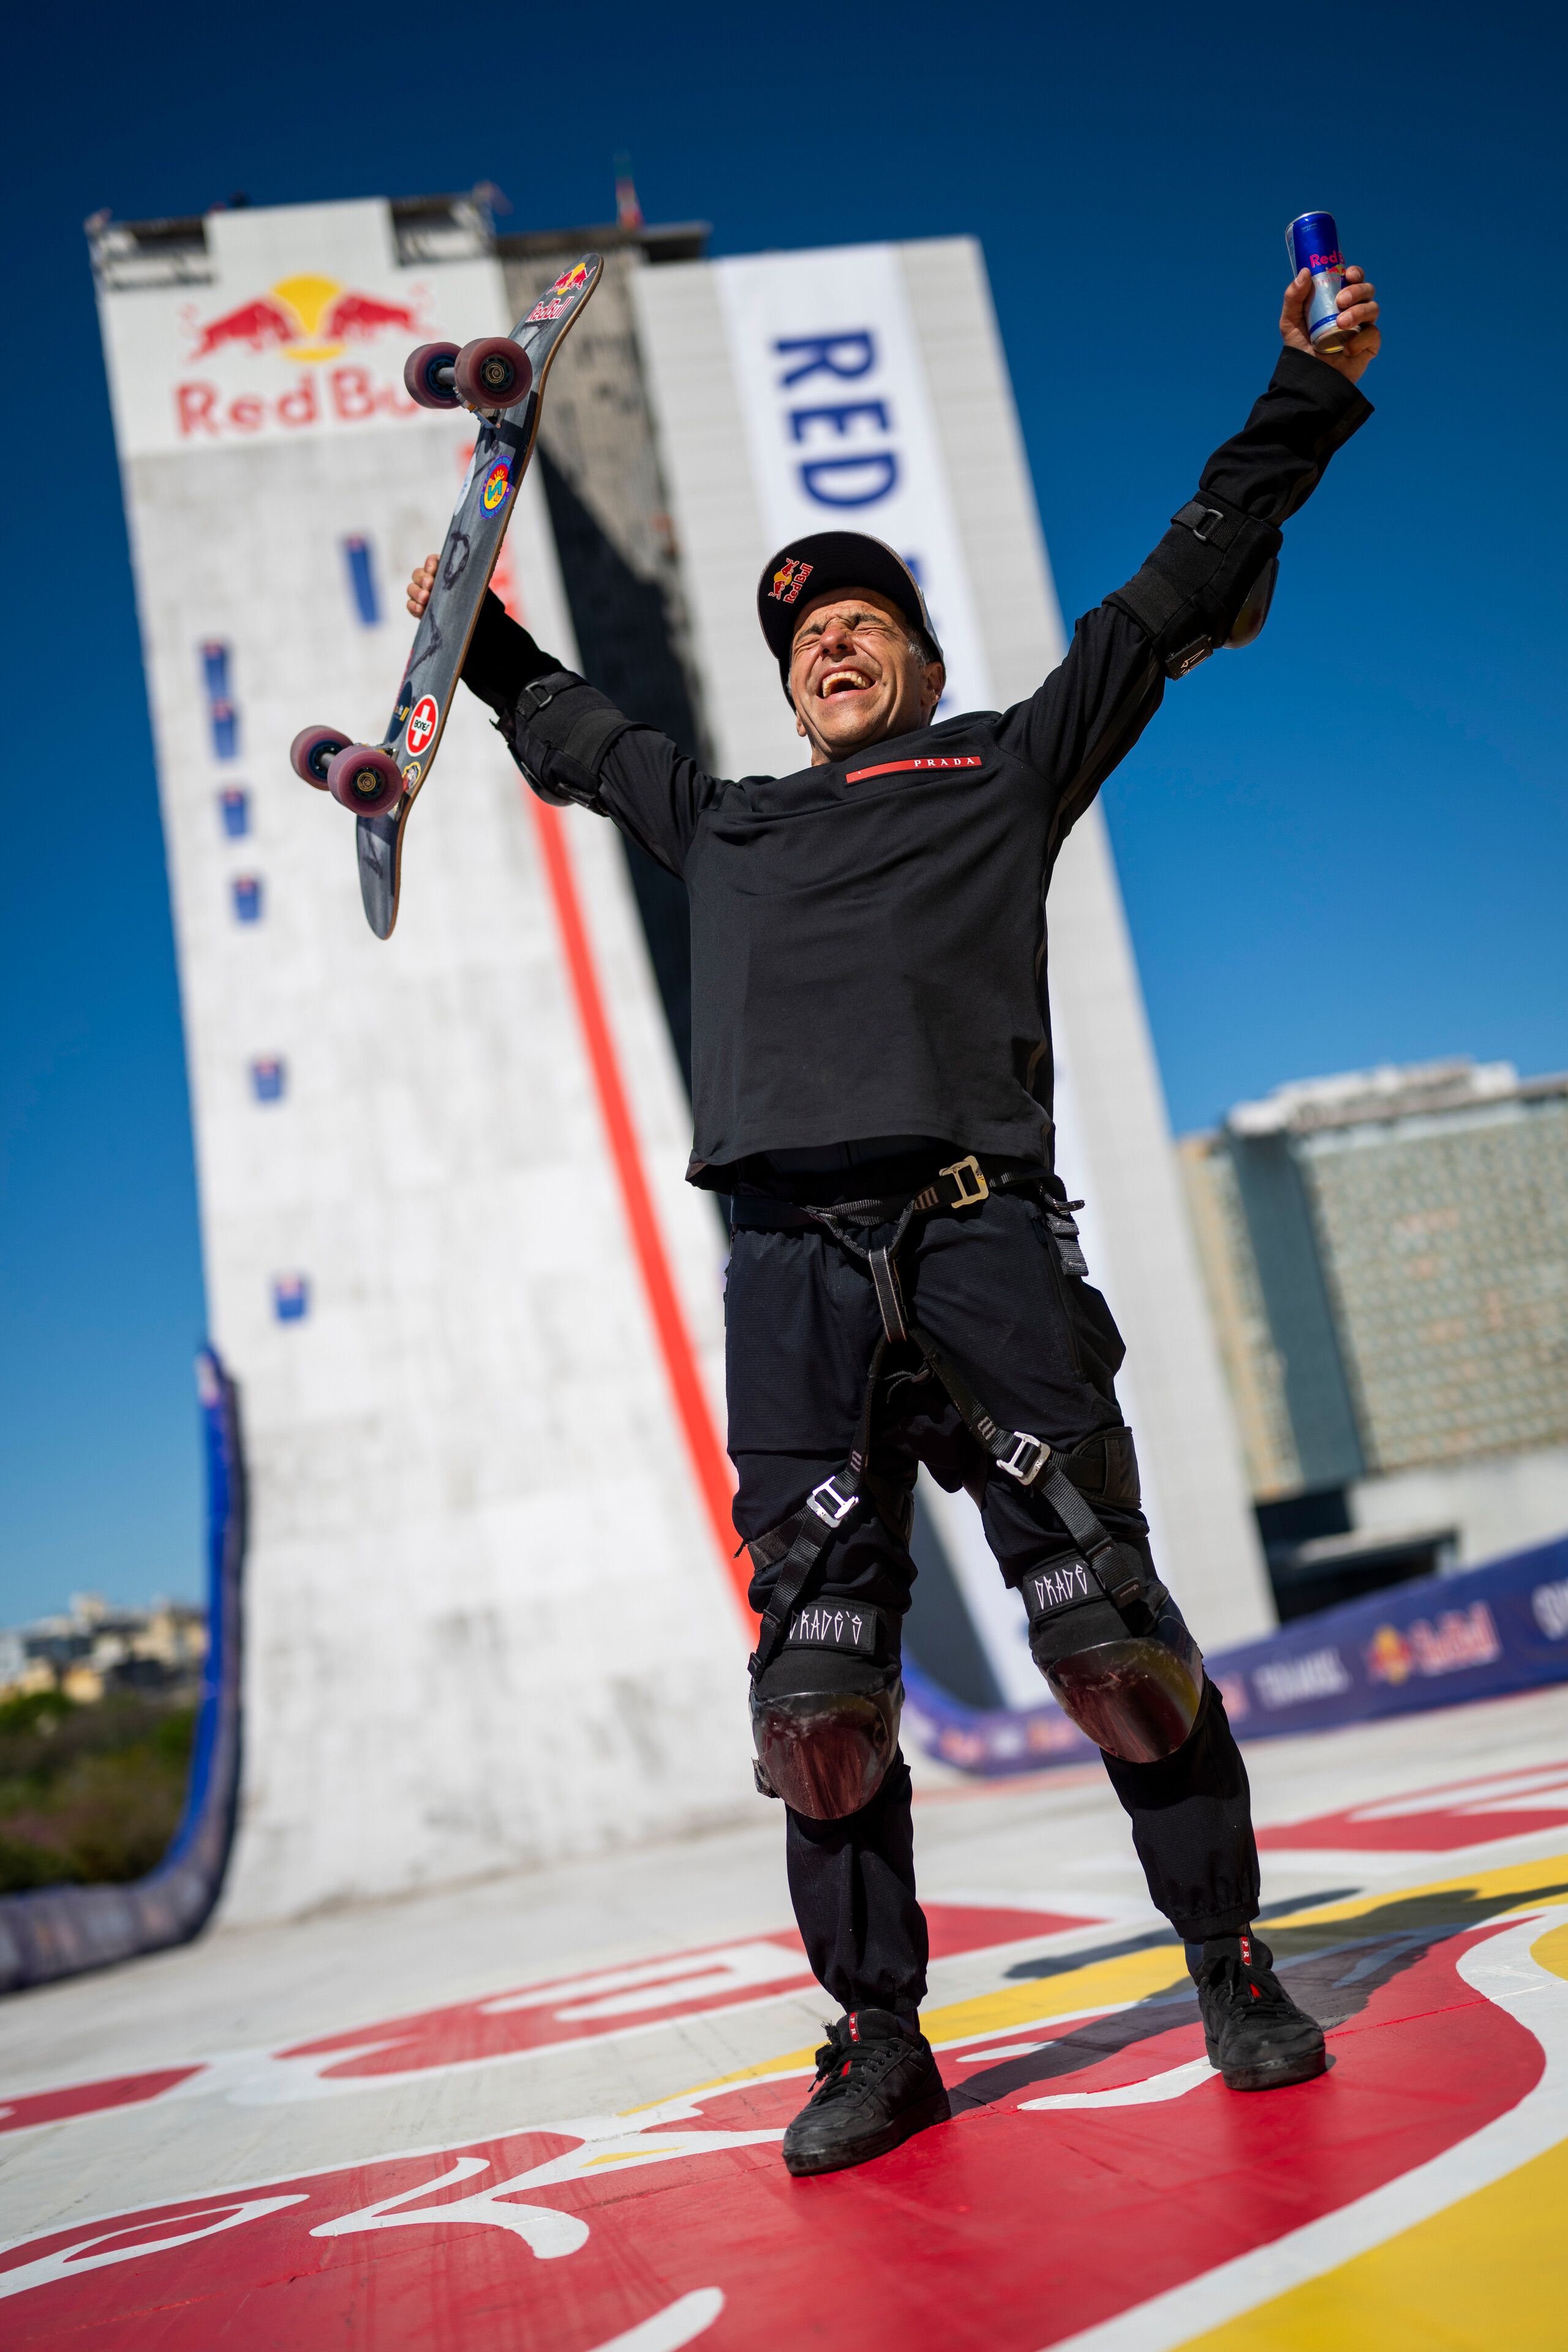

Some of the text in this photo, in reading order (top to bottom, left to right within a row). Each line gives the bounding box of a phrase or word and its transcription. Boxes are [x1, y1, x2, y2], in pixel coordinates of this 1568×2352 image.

[1309, 250, 1338, 268] Red
[175, 369, 318, 439] Red
[774, 329, 897, 509] RED
[783, 563, 813, 603] Red Bull
[914, 757, 975, 767] PRADA
